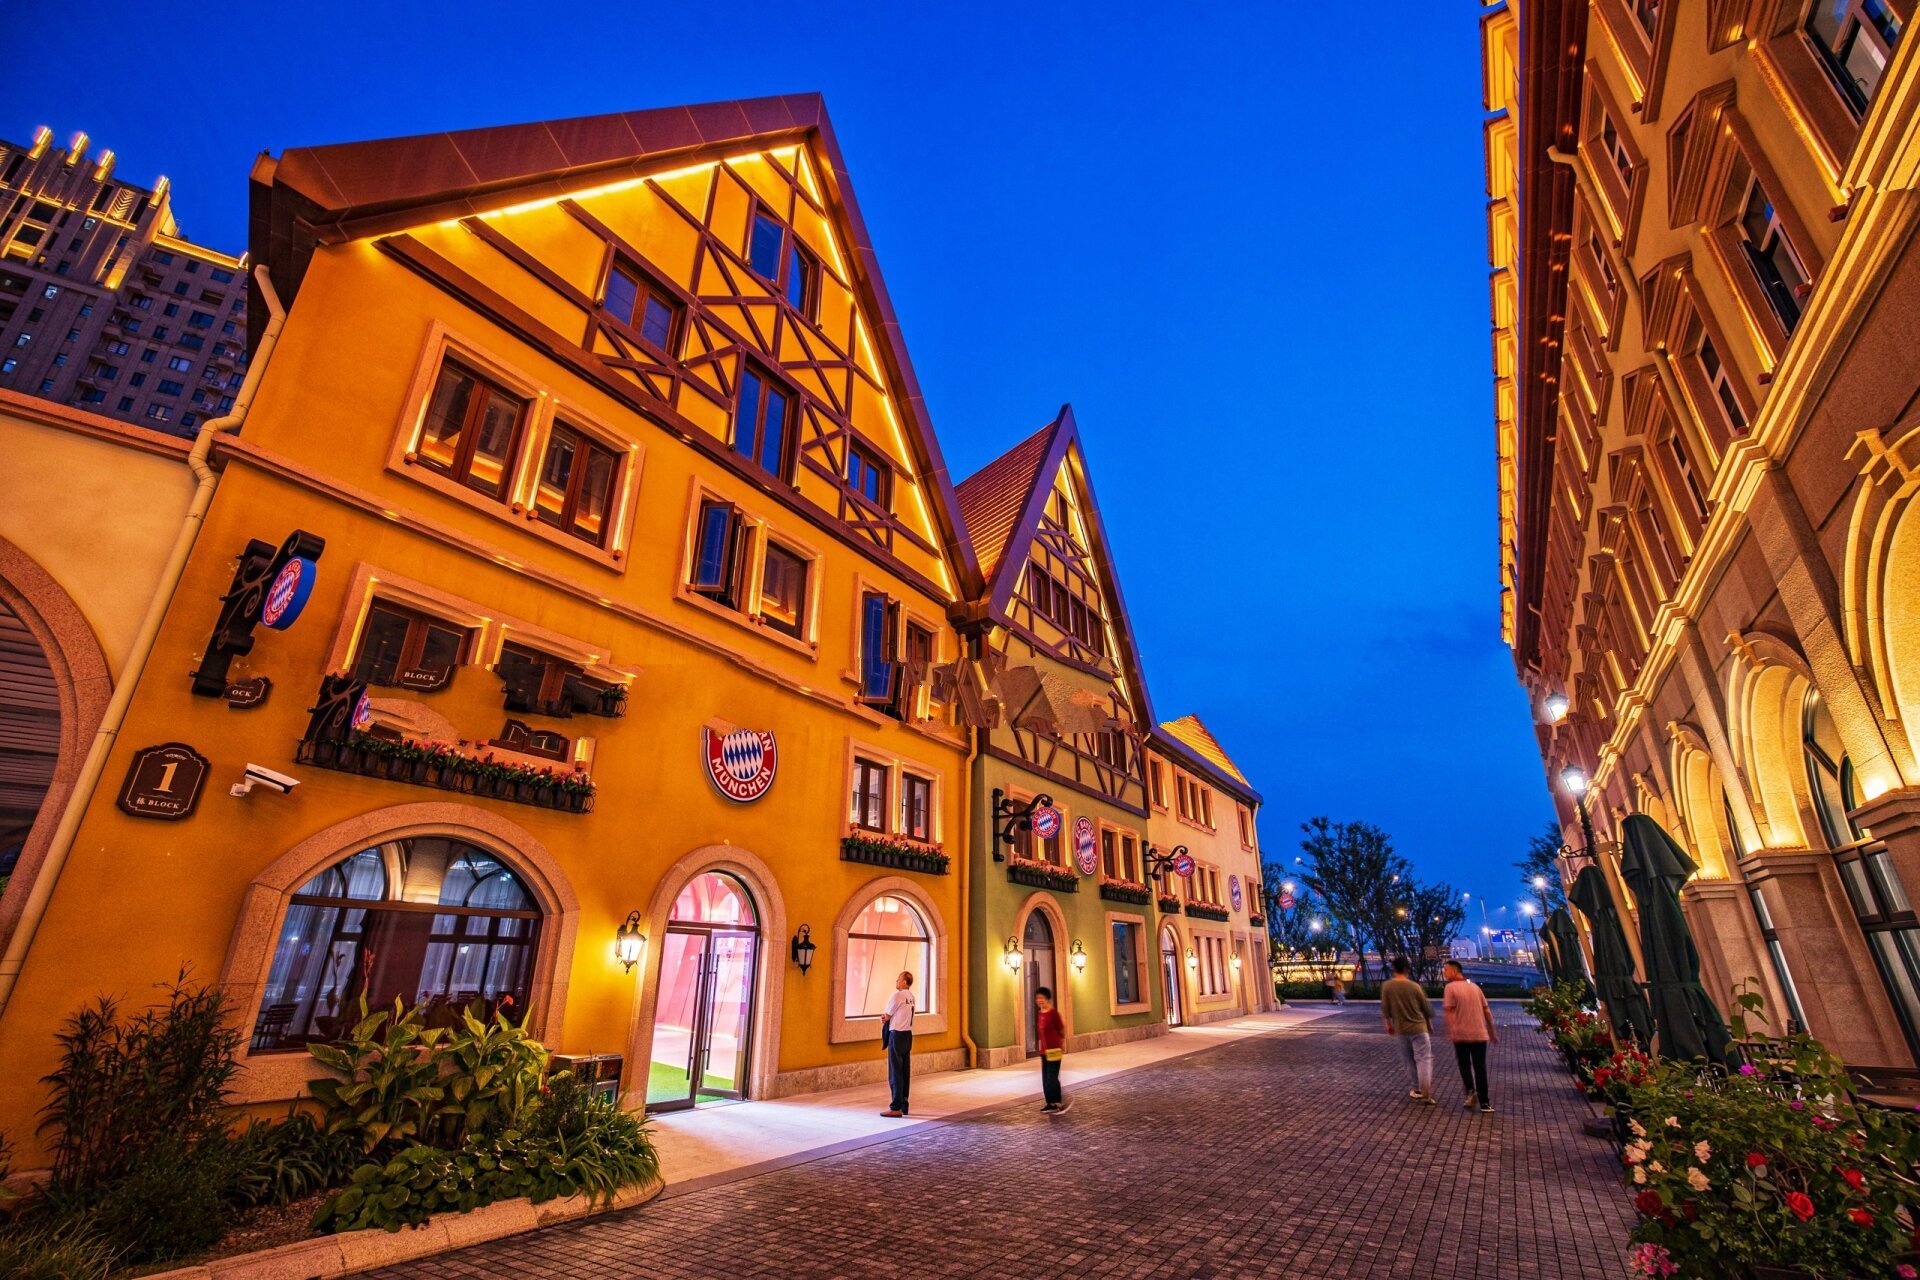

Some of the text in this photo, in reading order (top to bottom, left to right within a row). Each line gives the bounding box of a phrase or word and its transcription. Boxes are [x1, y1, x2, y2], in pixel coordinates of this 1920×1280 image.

[404, 671, 436, 681] BLOCK
[152, 762, 179, 793] 1
[712, 757, 772, 797] MÜNCHEN
[148, 800, 180, 809] BLOCK
